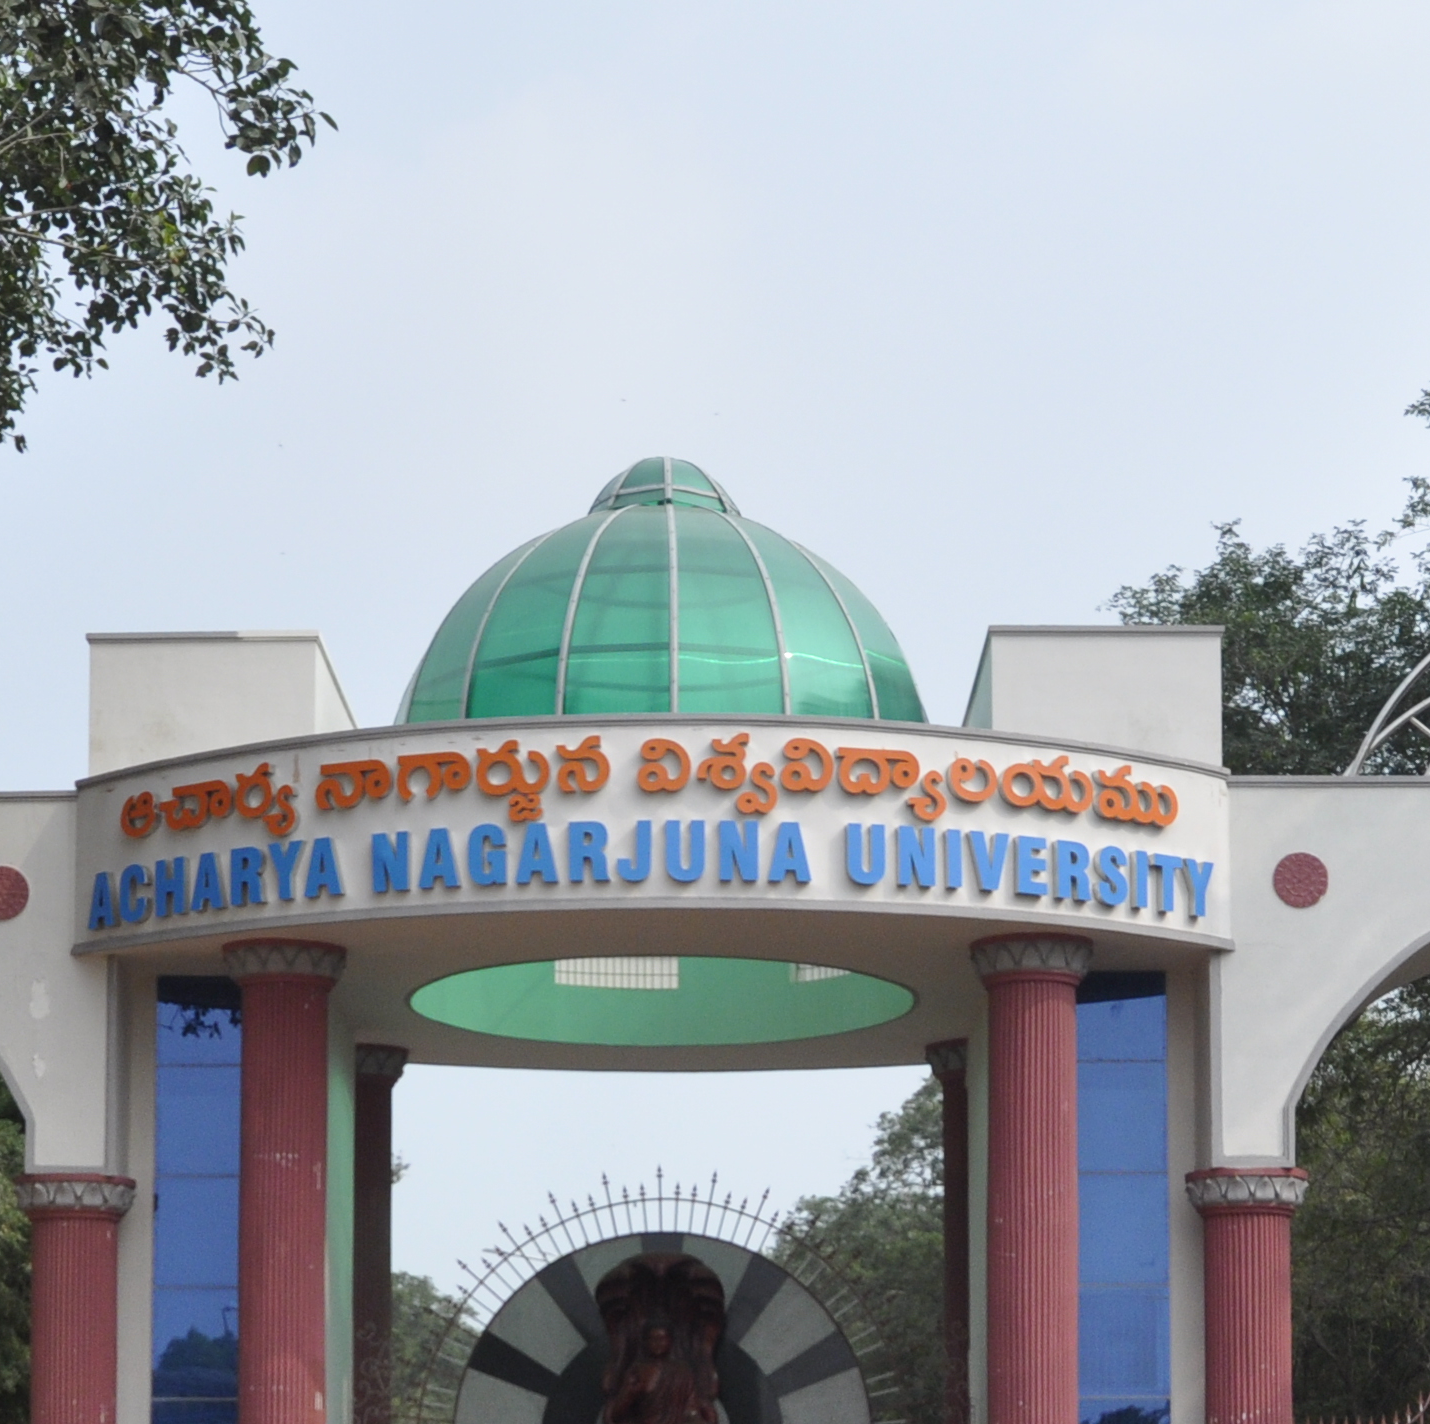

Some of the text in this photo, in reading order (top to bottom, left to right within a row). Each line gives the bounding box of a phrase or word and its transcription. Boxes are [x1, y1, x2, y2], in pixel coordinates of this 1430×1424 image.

[121, 732, 1179, 836] ఆచార్య నాగార్జున విశ్వవిద్యాలయము
[89, 820, 1214, 930] ACHARYA NAGARJUNA UNIVERSITY
